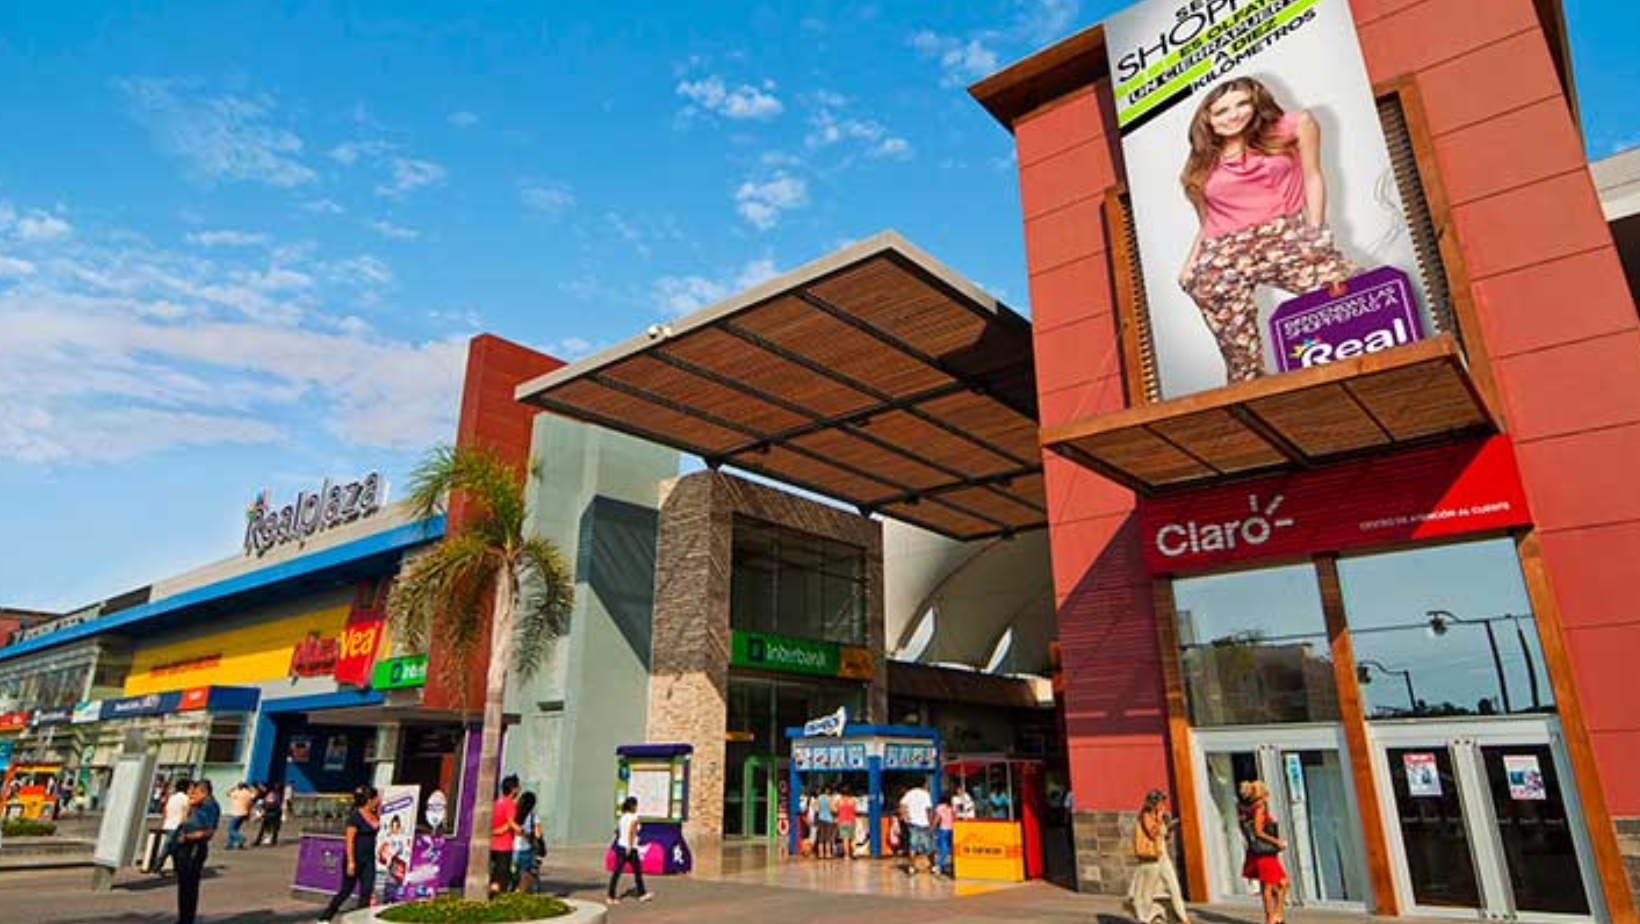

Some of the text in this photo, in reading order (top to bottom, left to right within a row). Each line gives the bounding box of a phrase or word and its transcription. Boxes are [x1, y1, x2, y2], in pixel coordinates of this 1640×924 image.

[1232, 17, 1277, 52] DIEZ
[1301, 318, 1408, 369] Real
[1156, 514, 1272, 556] Claro
